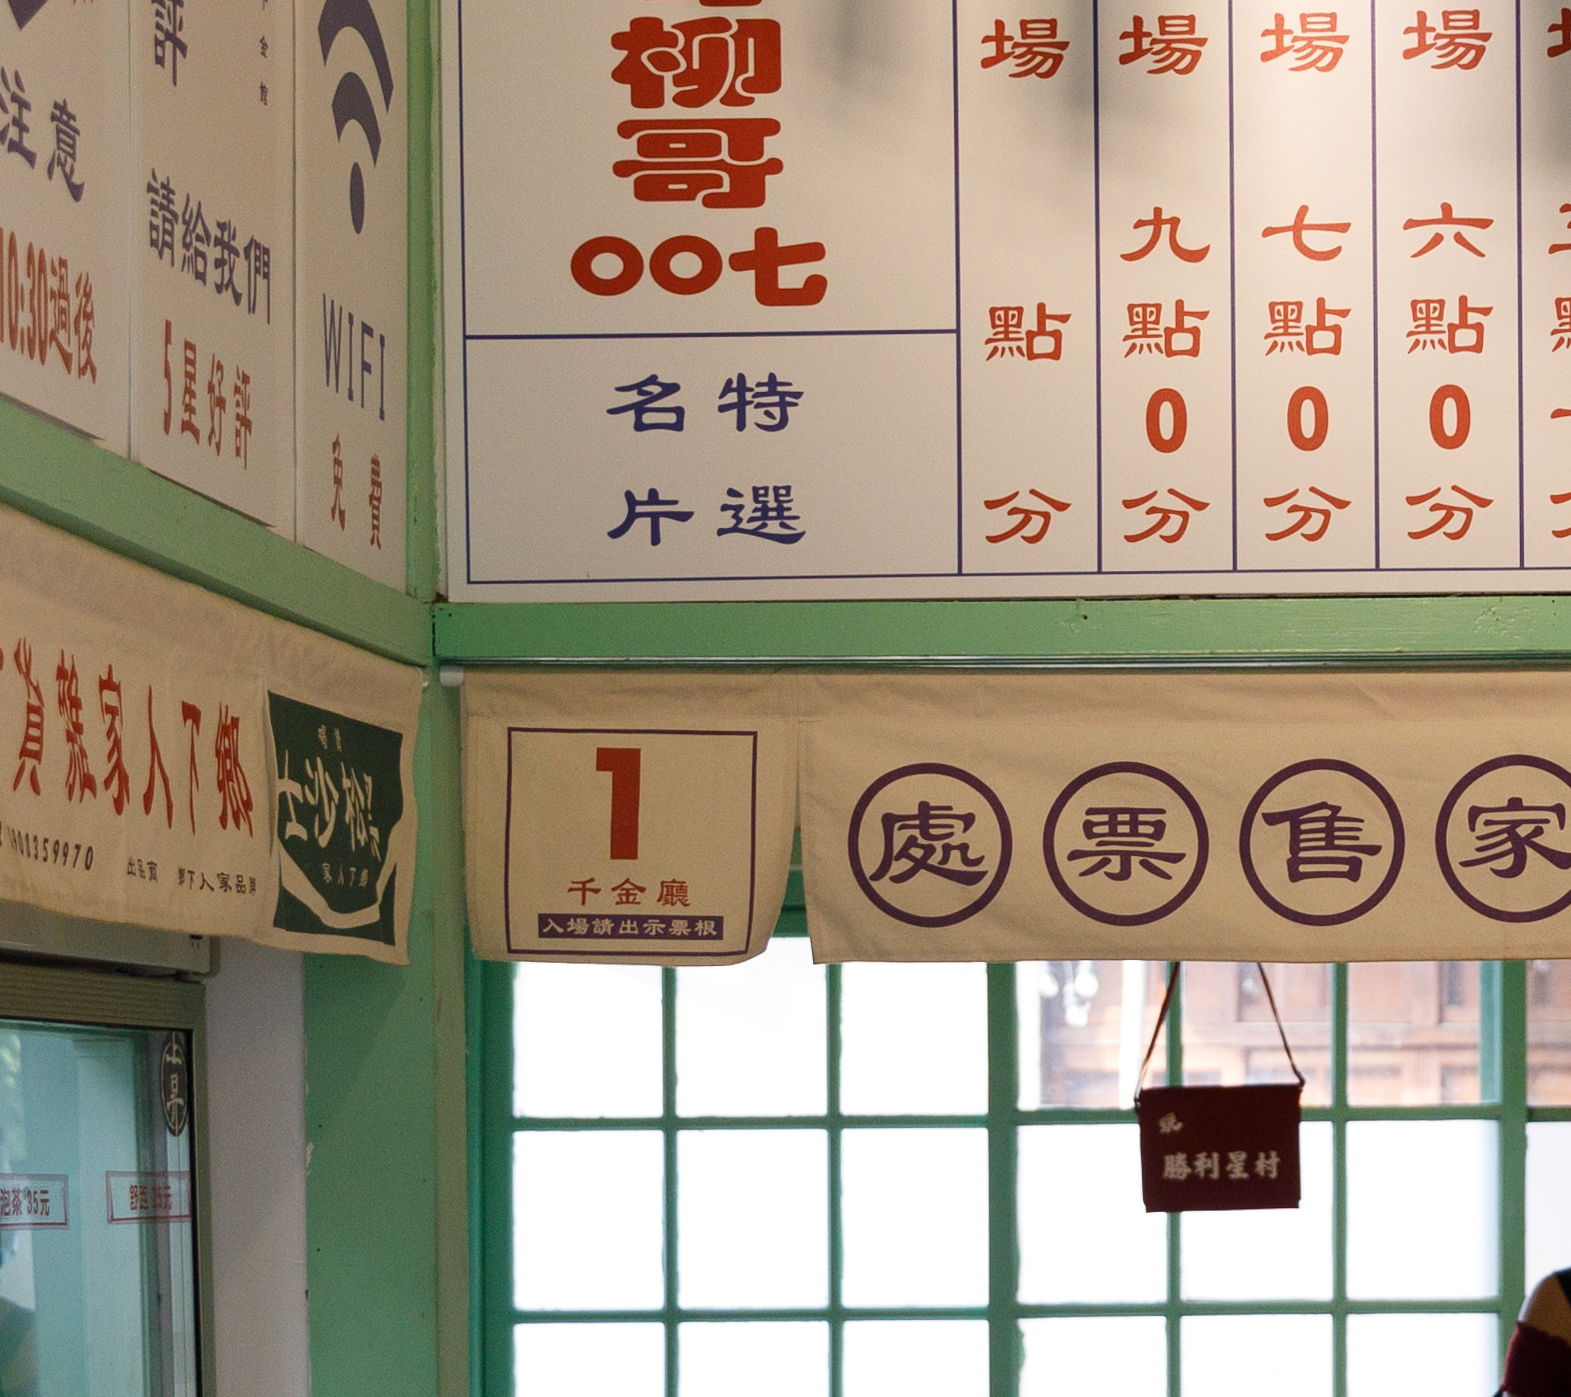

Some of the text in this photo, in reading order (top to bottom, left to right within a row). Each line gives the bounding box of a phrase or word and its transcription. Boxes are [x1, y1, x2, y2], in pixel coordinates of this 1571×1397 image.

[146, 167, 272, 327] 請給我們
[162, 318, 254, 472] 5星好評
[322, 293, 389, 423] WIFI
[330, 432, 385, 551] 免費
[594, 746, 642, 861] 1
[540, 915, 720, 941] 入場請出示票根
[565, 875, 692, 910] 千金廳
[1162, 1149, 1281, 1181] 勝利星村
